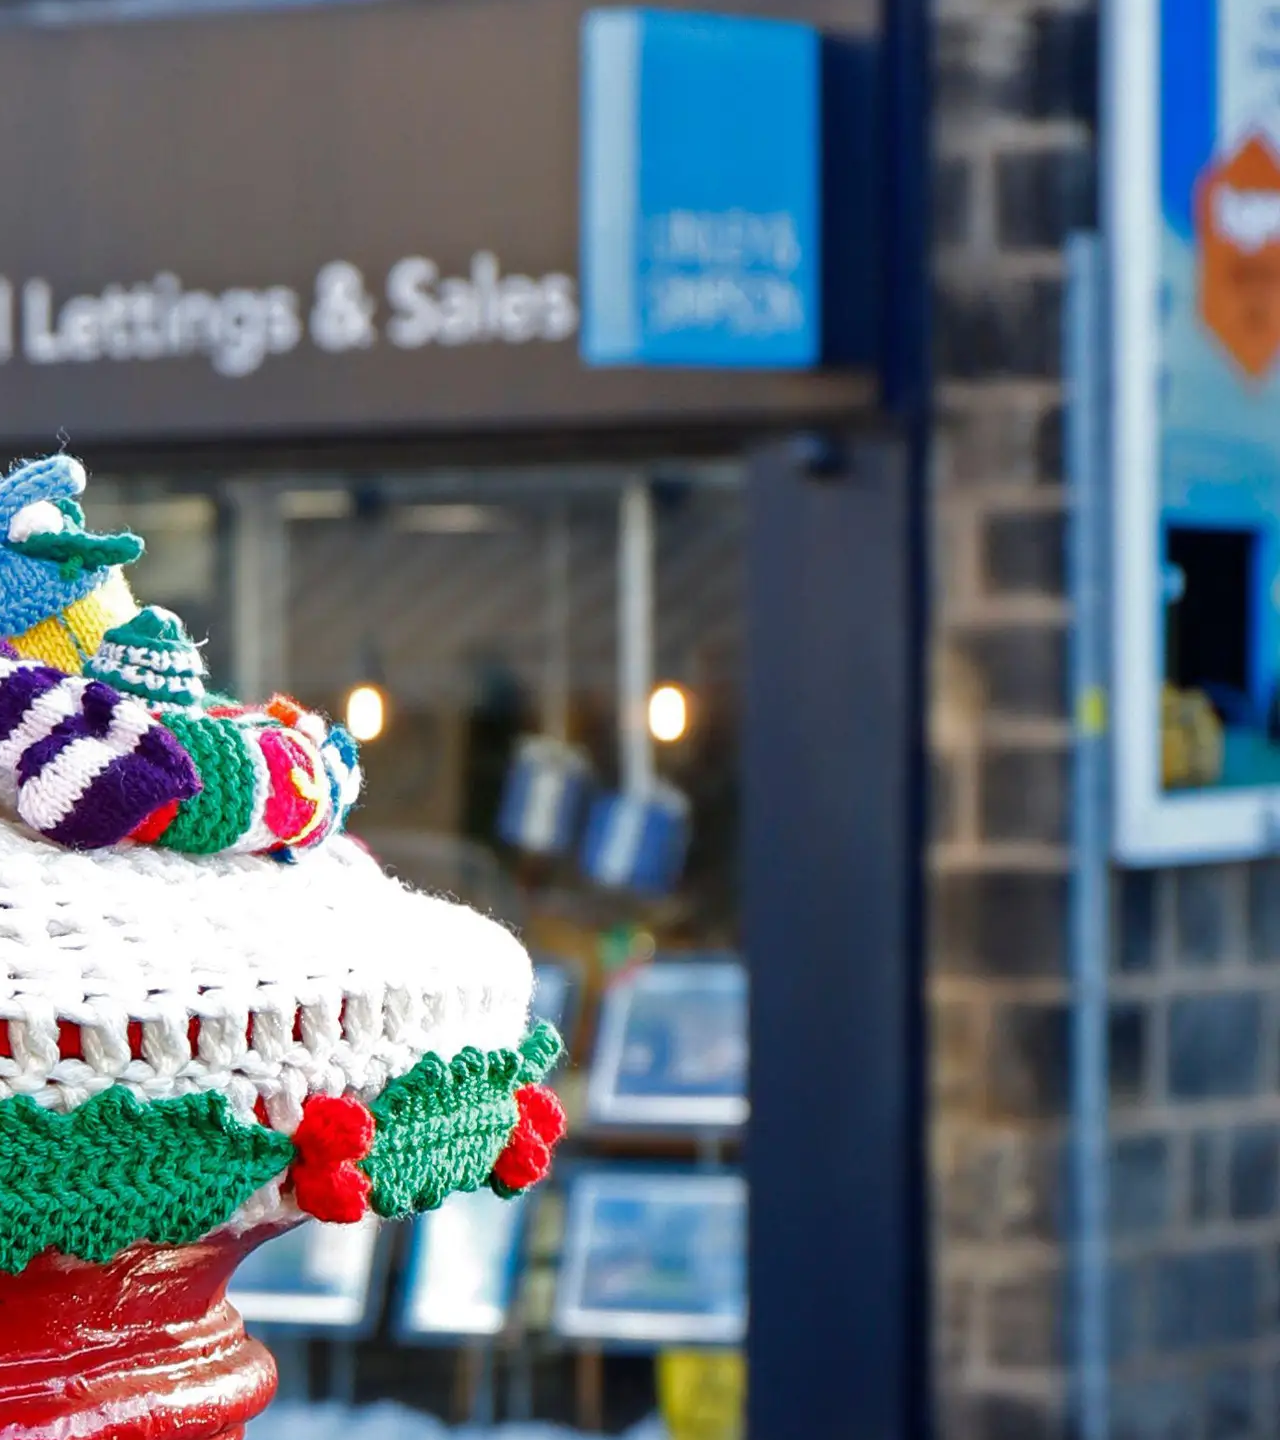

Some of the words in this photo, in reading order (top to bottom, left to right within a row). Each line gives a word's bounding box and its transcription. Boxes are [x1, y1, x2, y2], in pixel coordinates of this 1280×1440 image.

[25, 273, 298, 376] Lettings
[309, 262, 374, 351] &
[387, 252, 577, 348] Sales
